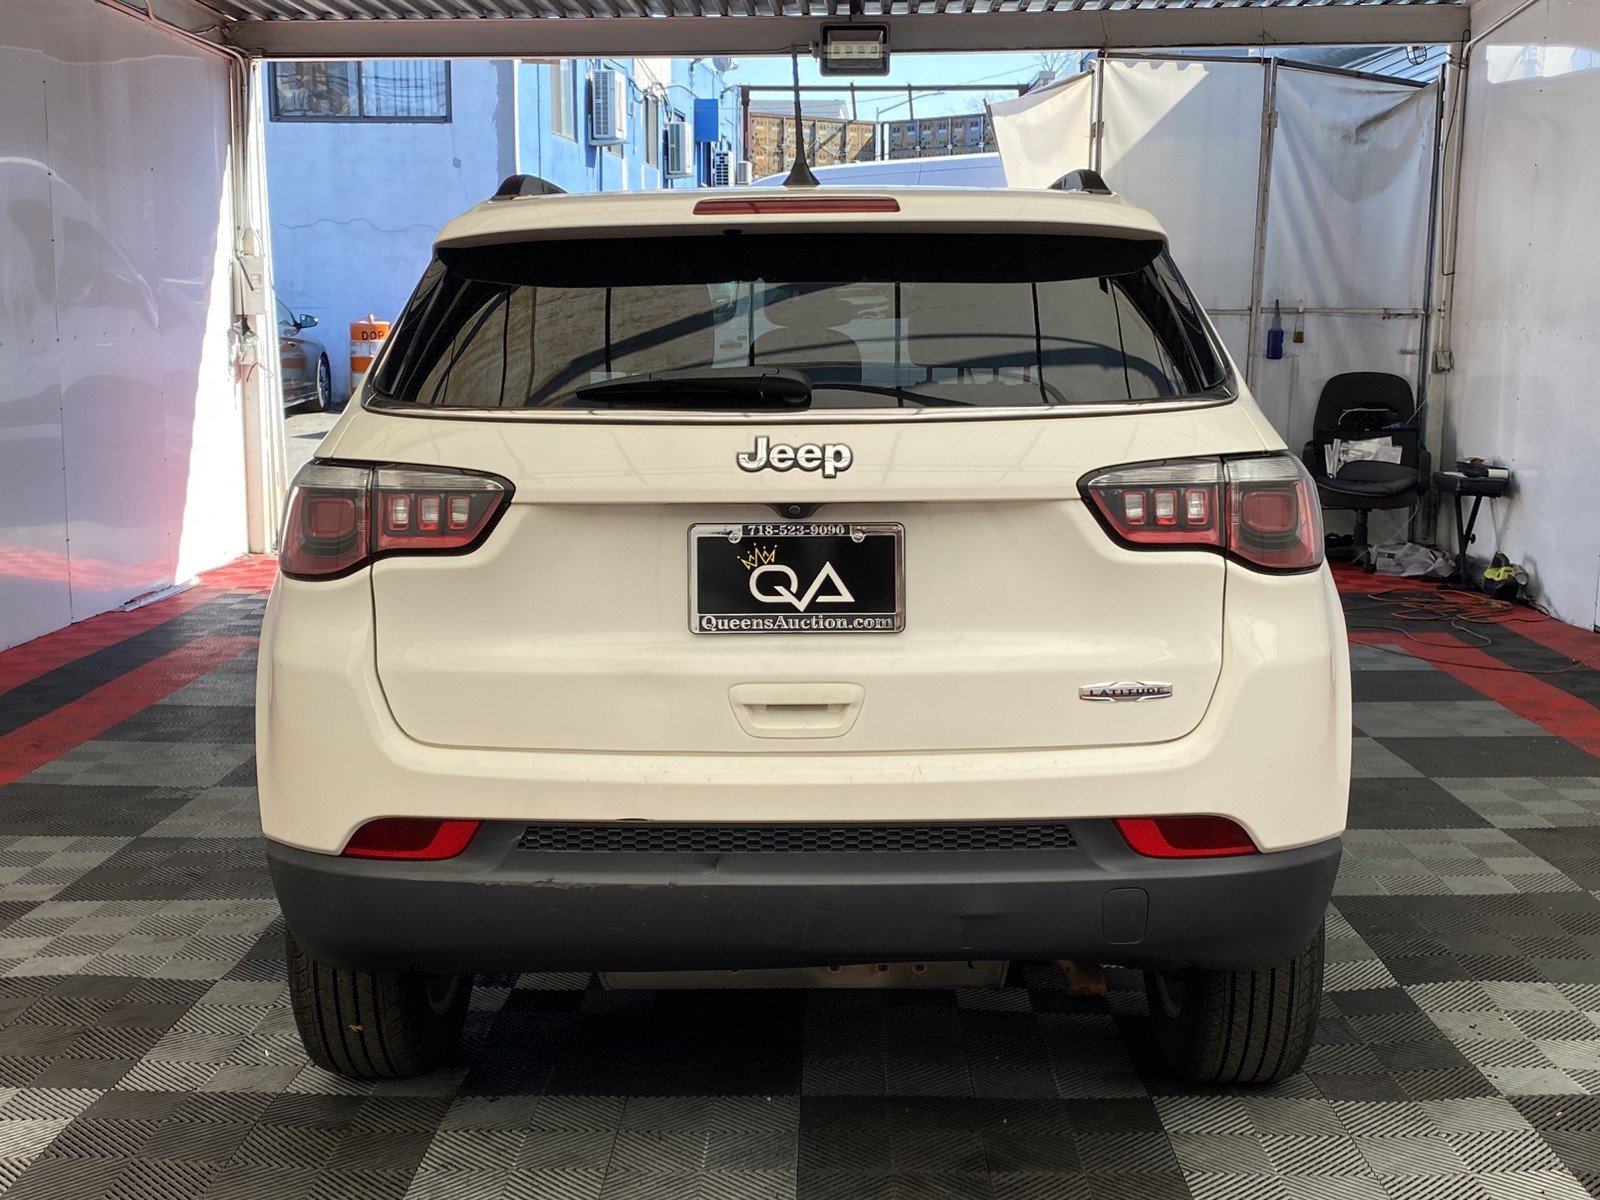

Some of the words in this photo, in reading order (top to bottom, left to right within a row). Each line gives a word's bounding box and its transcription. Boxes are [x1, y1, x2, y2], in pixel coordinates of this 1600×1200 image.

[737, 436, 853, 478] Jeep
[747, 524, 845, 536] 718-523-9090
[701, 615, 893, 631] QueensAuction.com
[1089, 687, 1166, 697] LATITUDE
